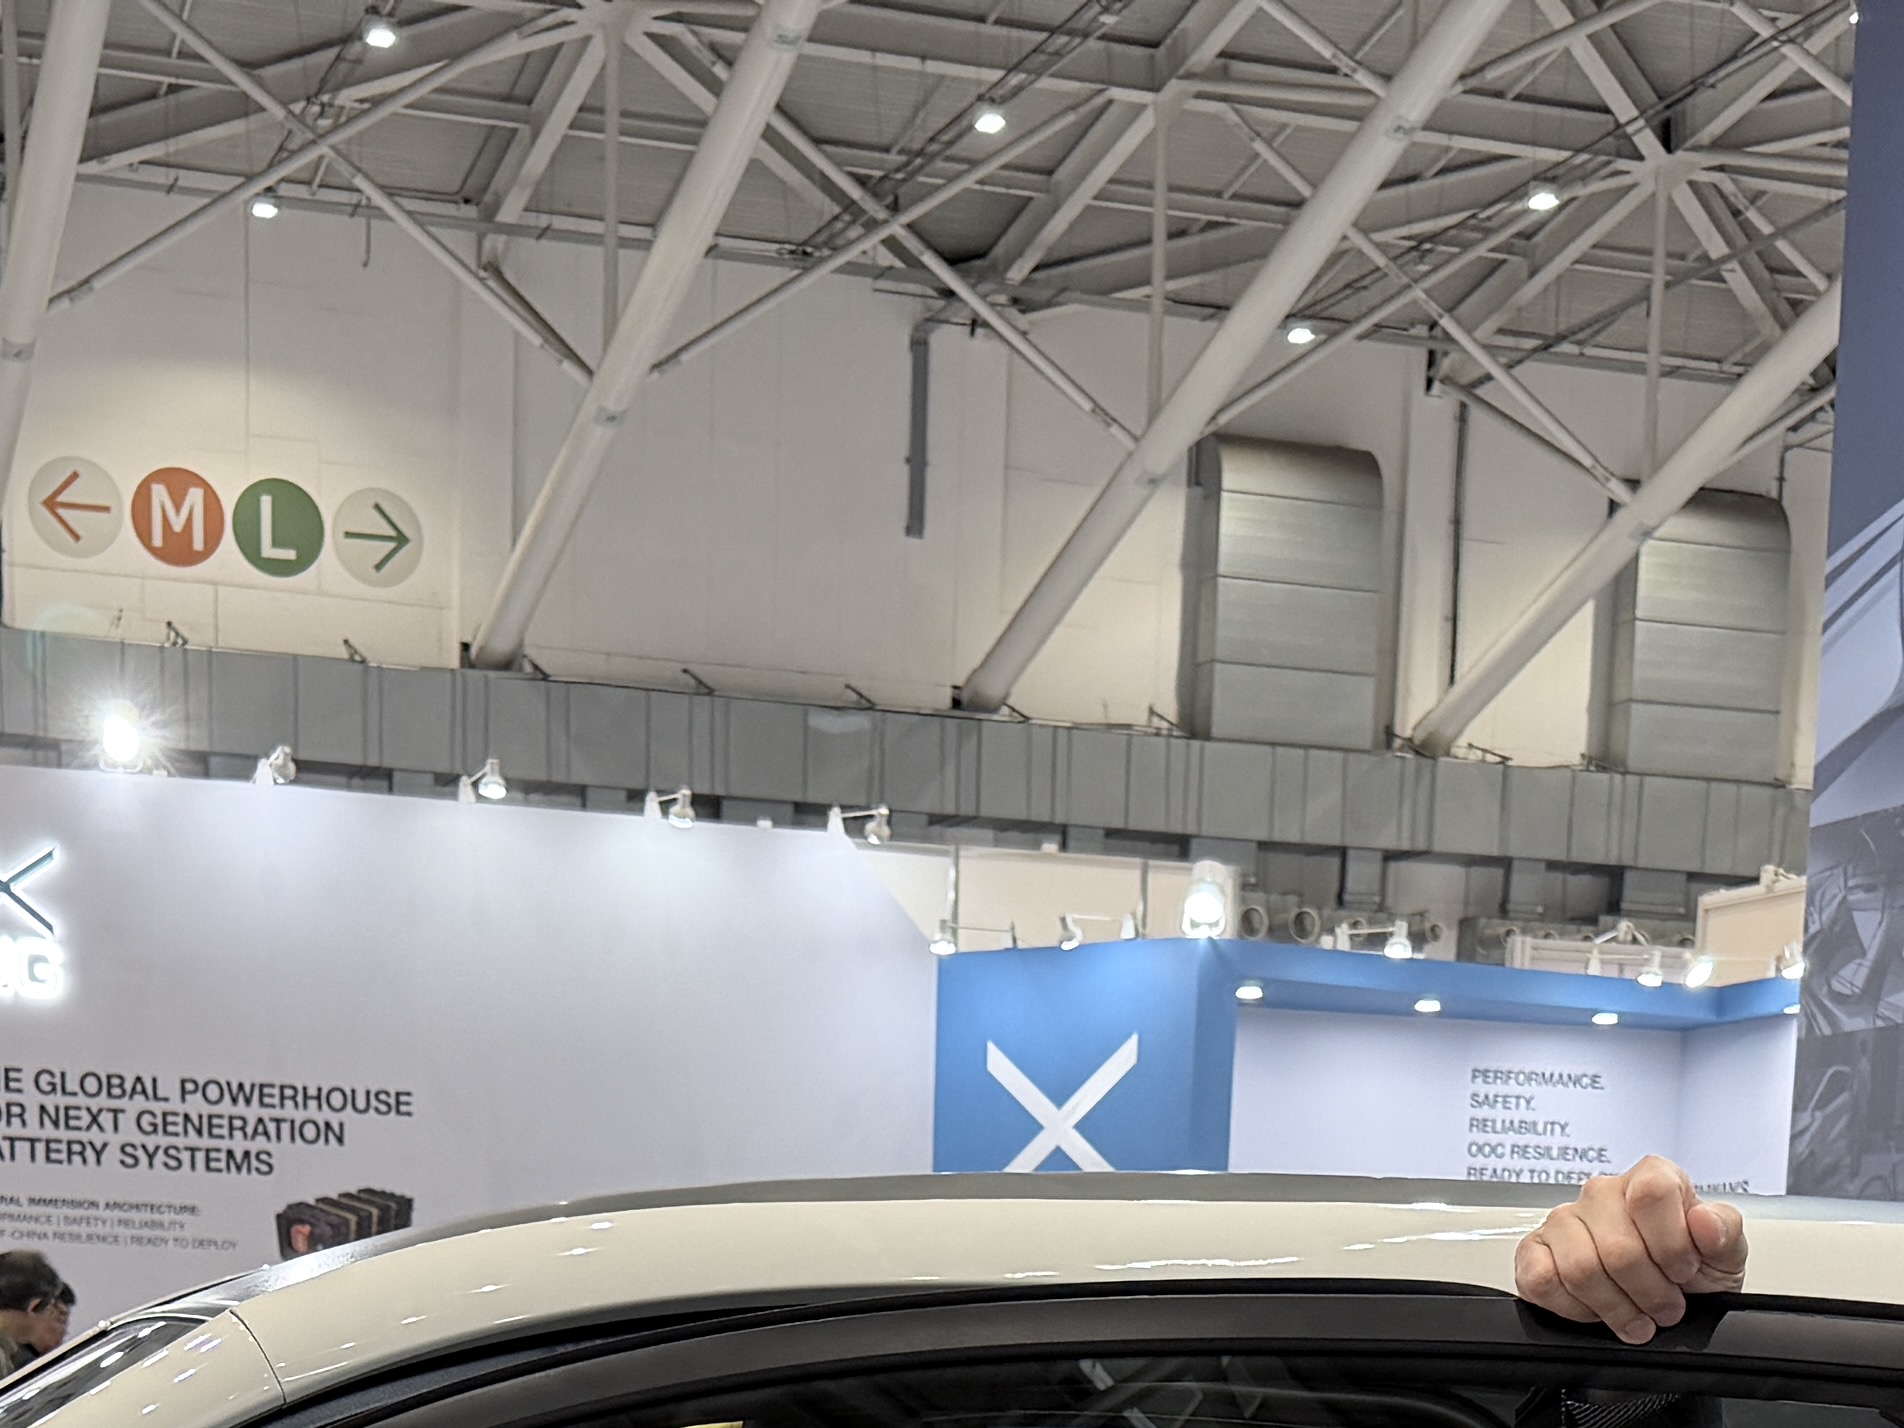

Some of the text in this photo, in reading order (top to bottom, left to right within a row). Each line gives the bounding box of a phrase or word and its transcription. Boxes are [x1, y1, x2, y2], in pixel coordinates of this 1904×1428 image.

[150, 482, 206, 552] M
[260, 494, 297, 561] L
[32, 1069, 169, 1102] GLOBAL
[179, 1078, 414, 1117] POWERHOUSE
[1470, 1068, 1606, 1091] PERFORMANCE.
[1469, 1092, 1536, 1112] SAFETY.
[38, 1103, 125, 1135] NEXT
[135, 1111, 346, 1148] GENERATION
[1468, 1117, 1571, 1138] RELIABILITY.
[118, 1143, 275, 1176] SYSTEMS
